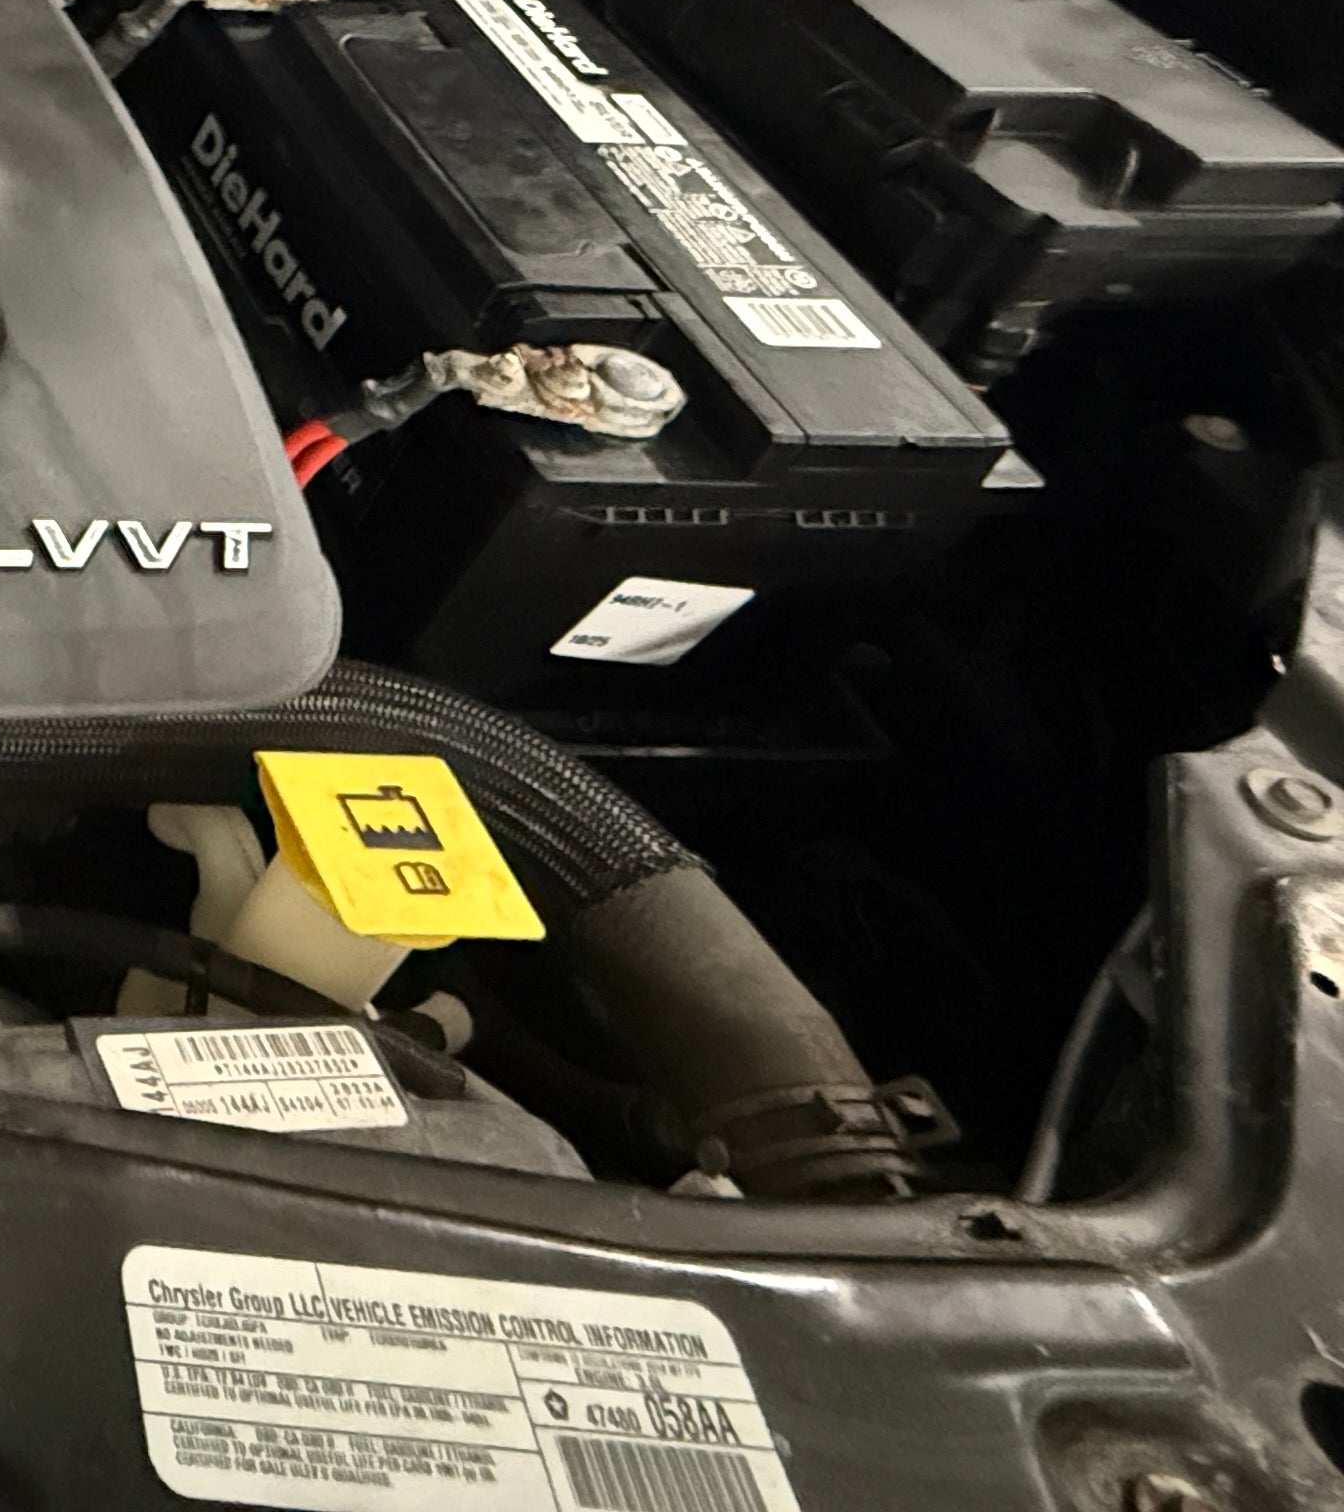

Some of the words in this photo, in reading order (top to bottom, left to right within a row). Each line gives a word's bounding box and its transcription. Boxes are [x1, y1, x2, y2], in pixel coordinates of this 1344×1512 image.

[191, 112, 348, 352] DieHard
[32, 518, 273, 571] VVT
[148, 1278, 223, 1311] Chrysler
[229, 1286, 285, 1319] Group
[289, 1292, 325, 1319] LLC
[329, 1296, 407, 1327] VEHICLE
[408, 1303, 496, 1336] EMISSION
[498, 1313, 583, 1346] CONTROL
[582, 1322, 709, 1359] INFORMATION
[642, 1391, 742, 1445] 058AA
